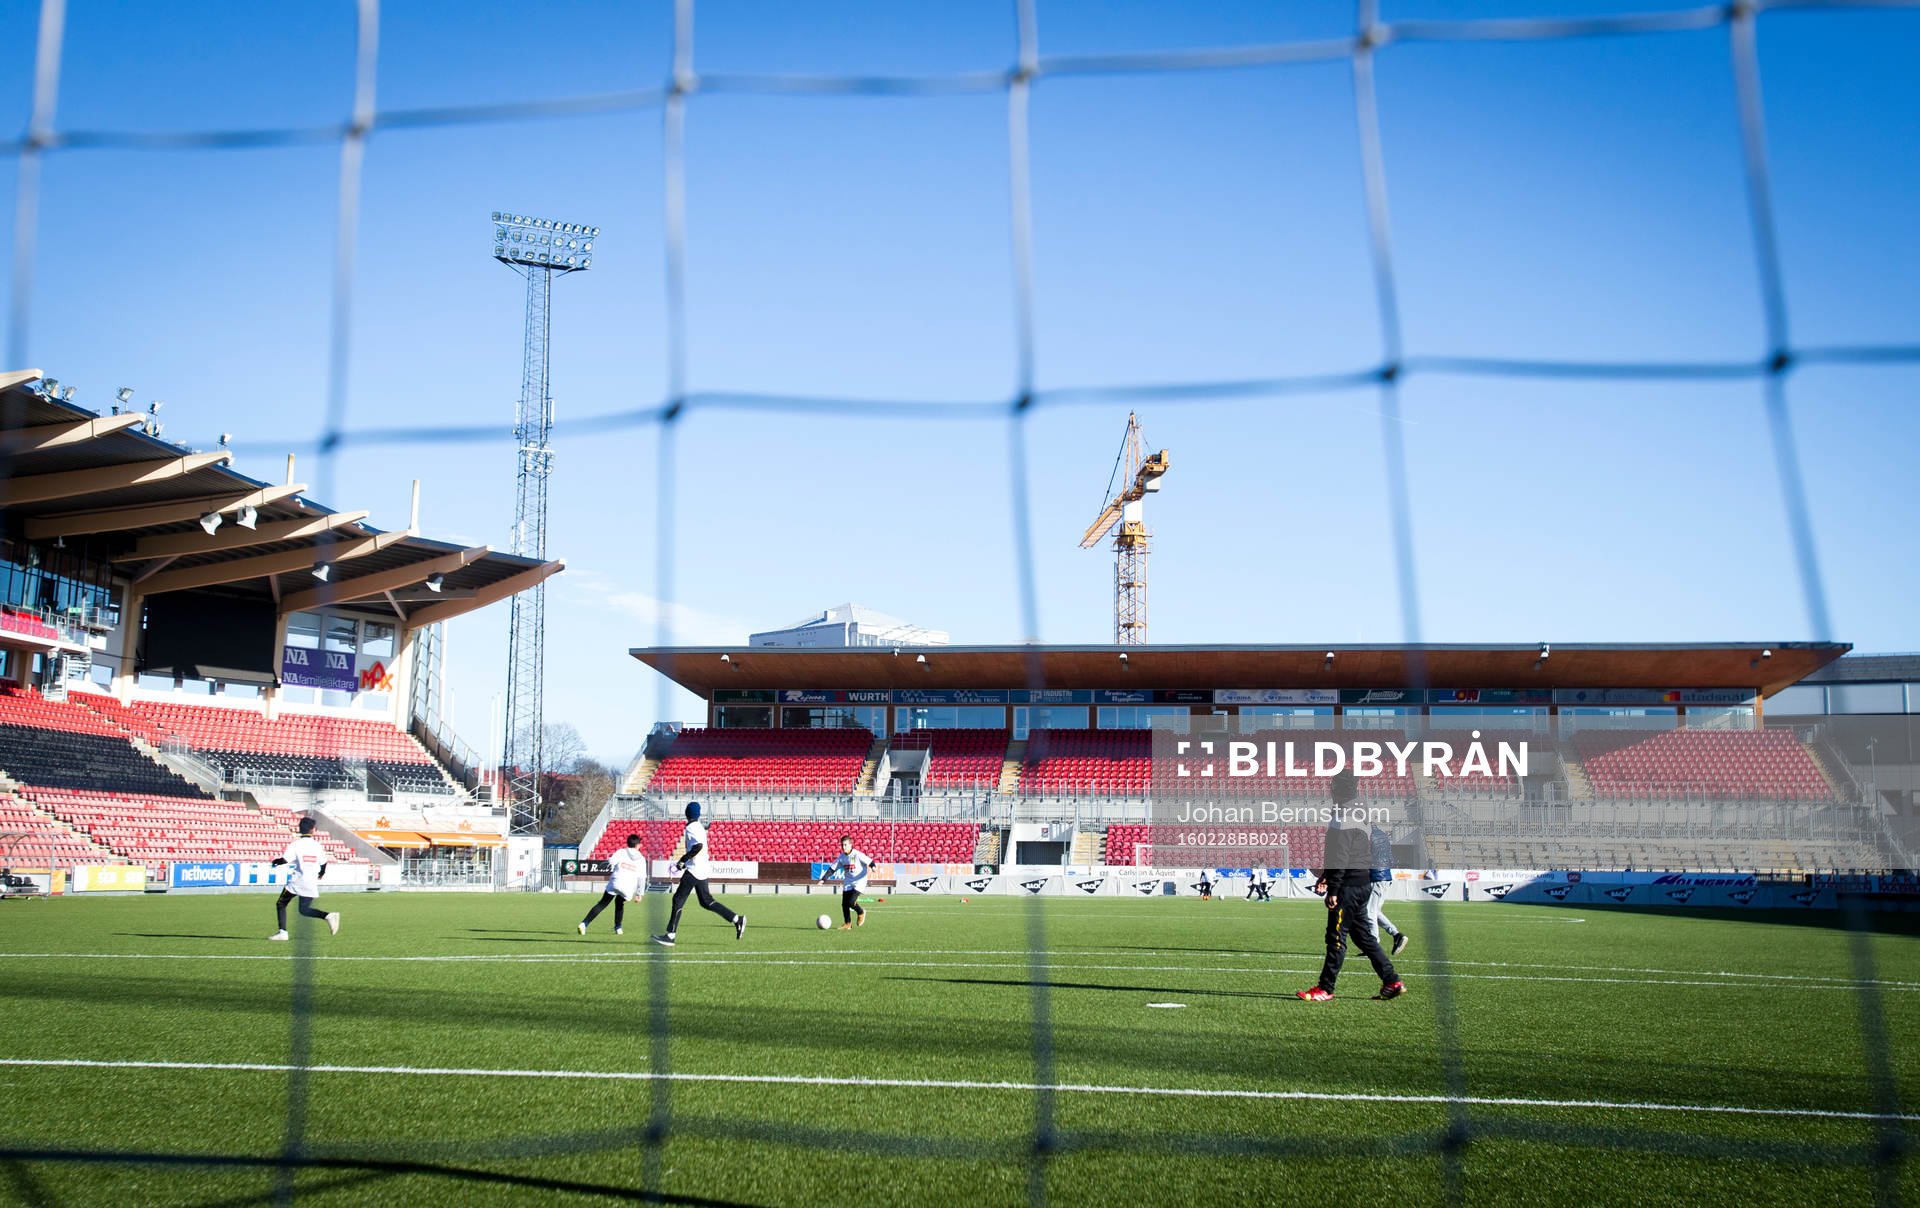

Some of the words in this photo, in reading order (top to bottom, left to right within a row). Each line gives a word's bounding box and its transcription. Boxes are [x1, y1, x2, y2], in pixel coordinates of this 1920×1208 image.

[284, 647, 309, 666] NA
[325, 652, 349, 670] NA
[181, 865, 224, 881] nethouse
[710, 864, 744, 874] hornton
